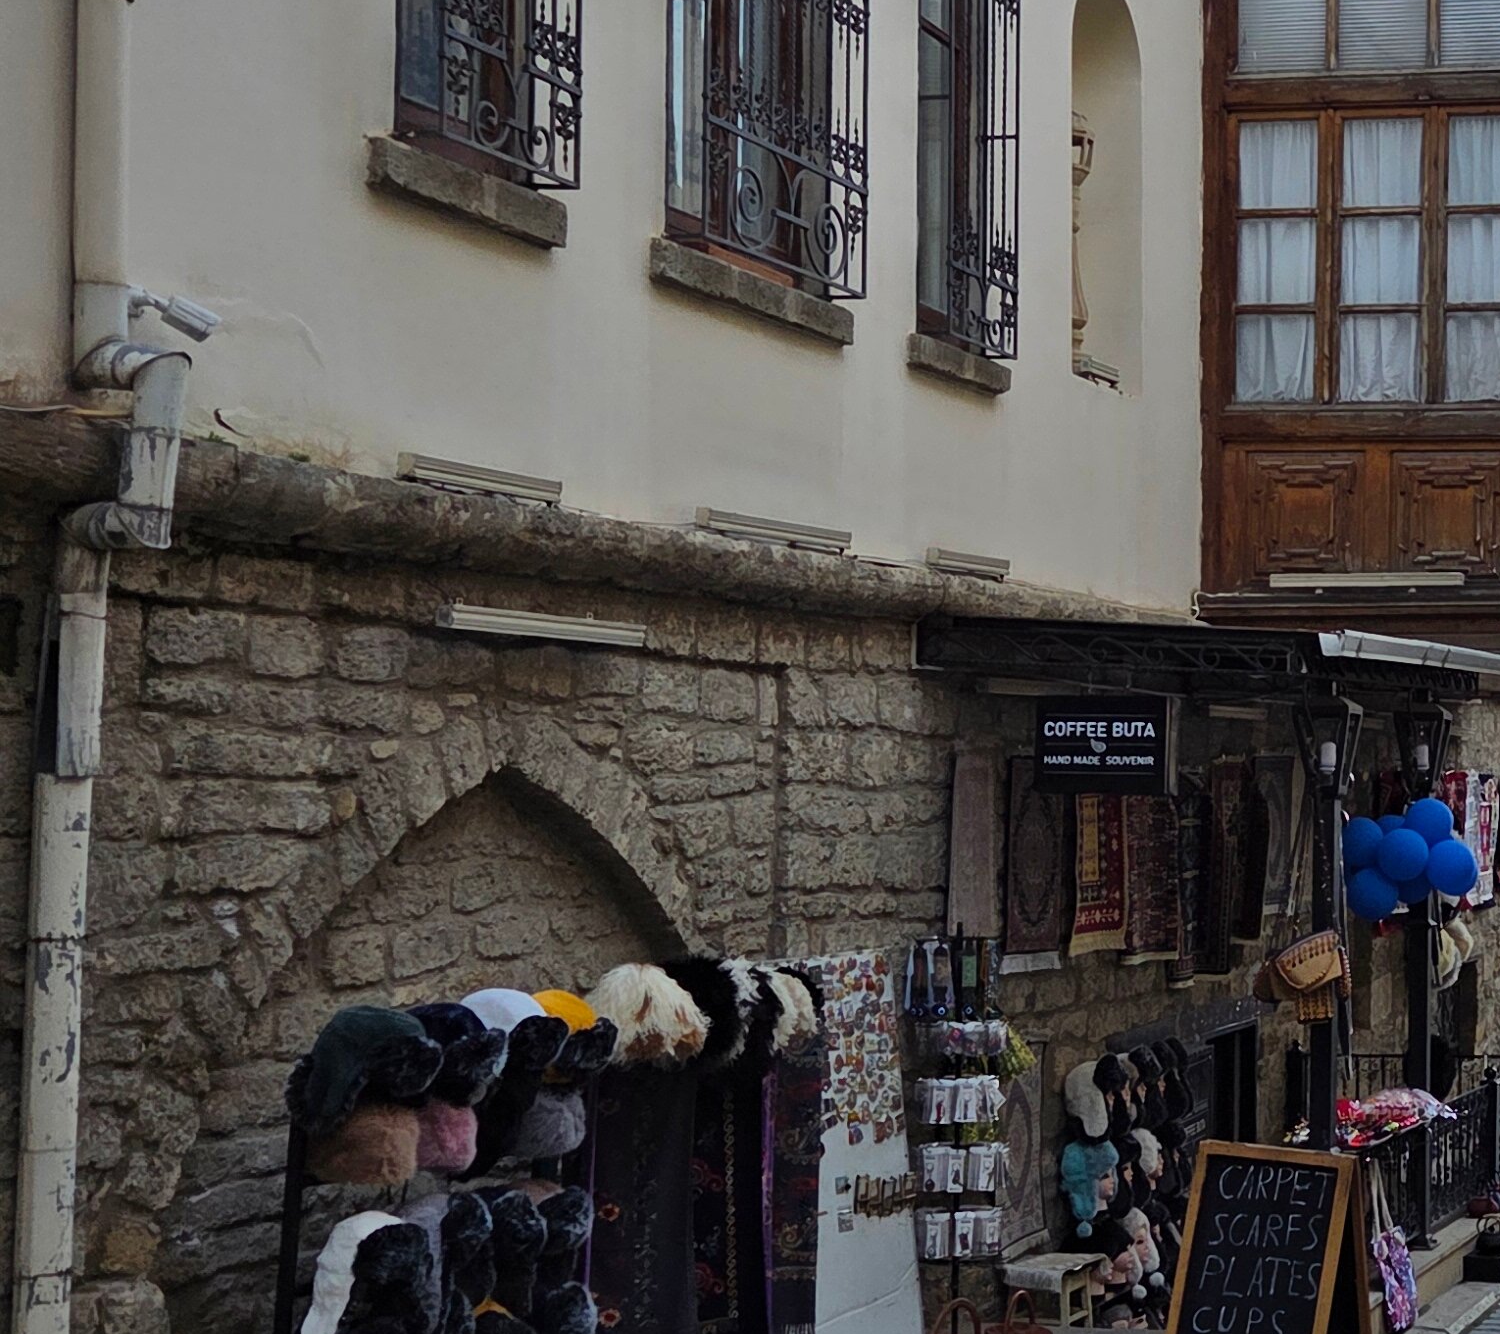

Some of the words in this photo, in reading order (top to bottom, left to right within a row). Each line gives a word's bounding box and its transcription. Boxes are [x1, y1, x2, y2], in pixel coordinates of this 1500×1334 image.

[1044, 721, 1107, 737] COFFEE
[1112, 721, 1156, 738] BUTA
[1043, 755, 1071, 765] HAND
[1073, 755, 1100, 765] MADE
[1105, 755, 1154, 766] SOUVENIR
[1219, 1165, 1335, 1209] CARPET
[1208, 1213, 1323, 1251] SCARFS
[1199, 1254, 1321, 1300] PLATES
